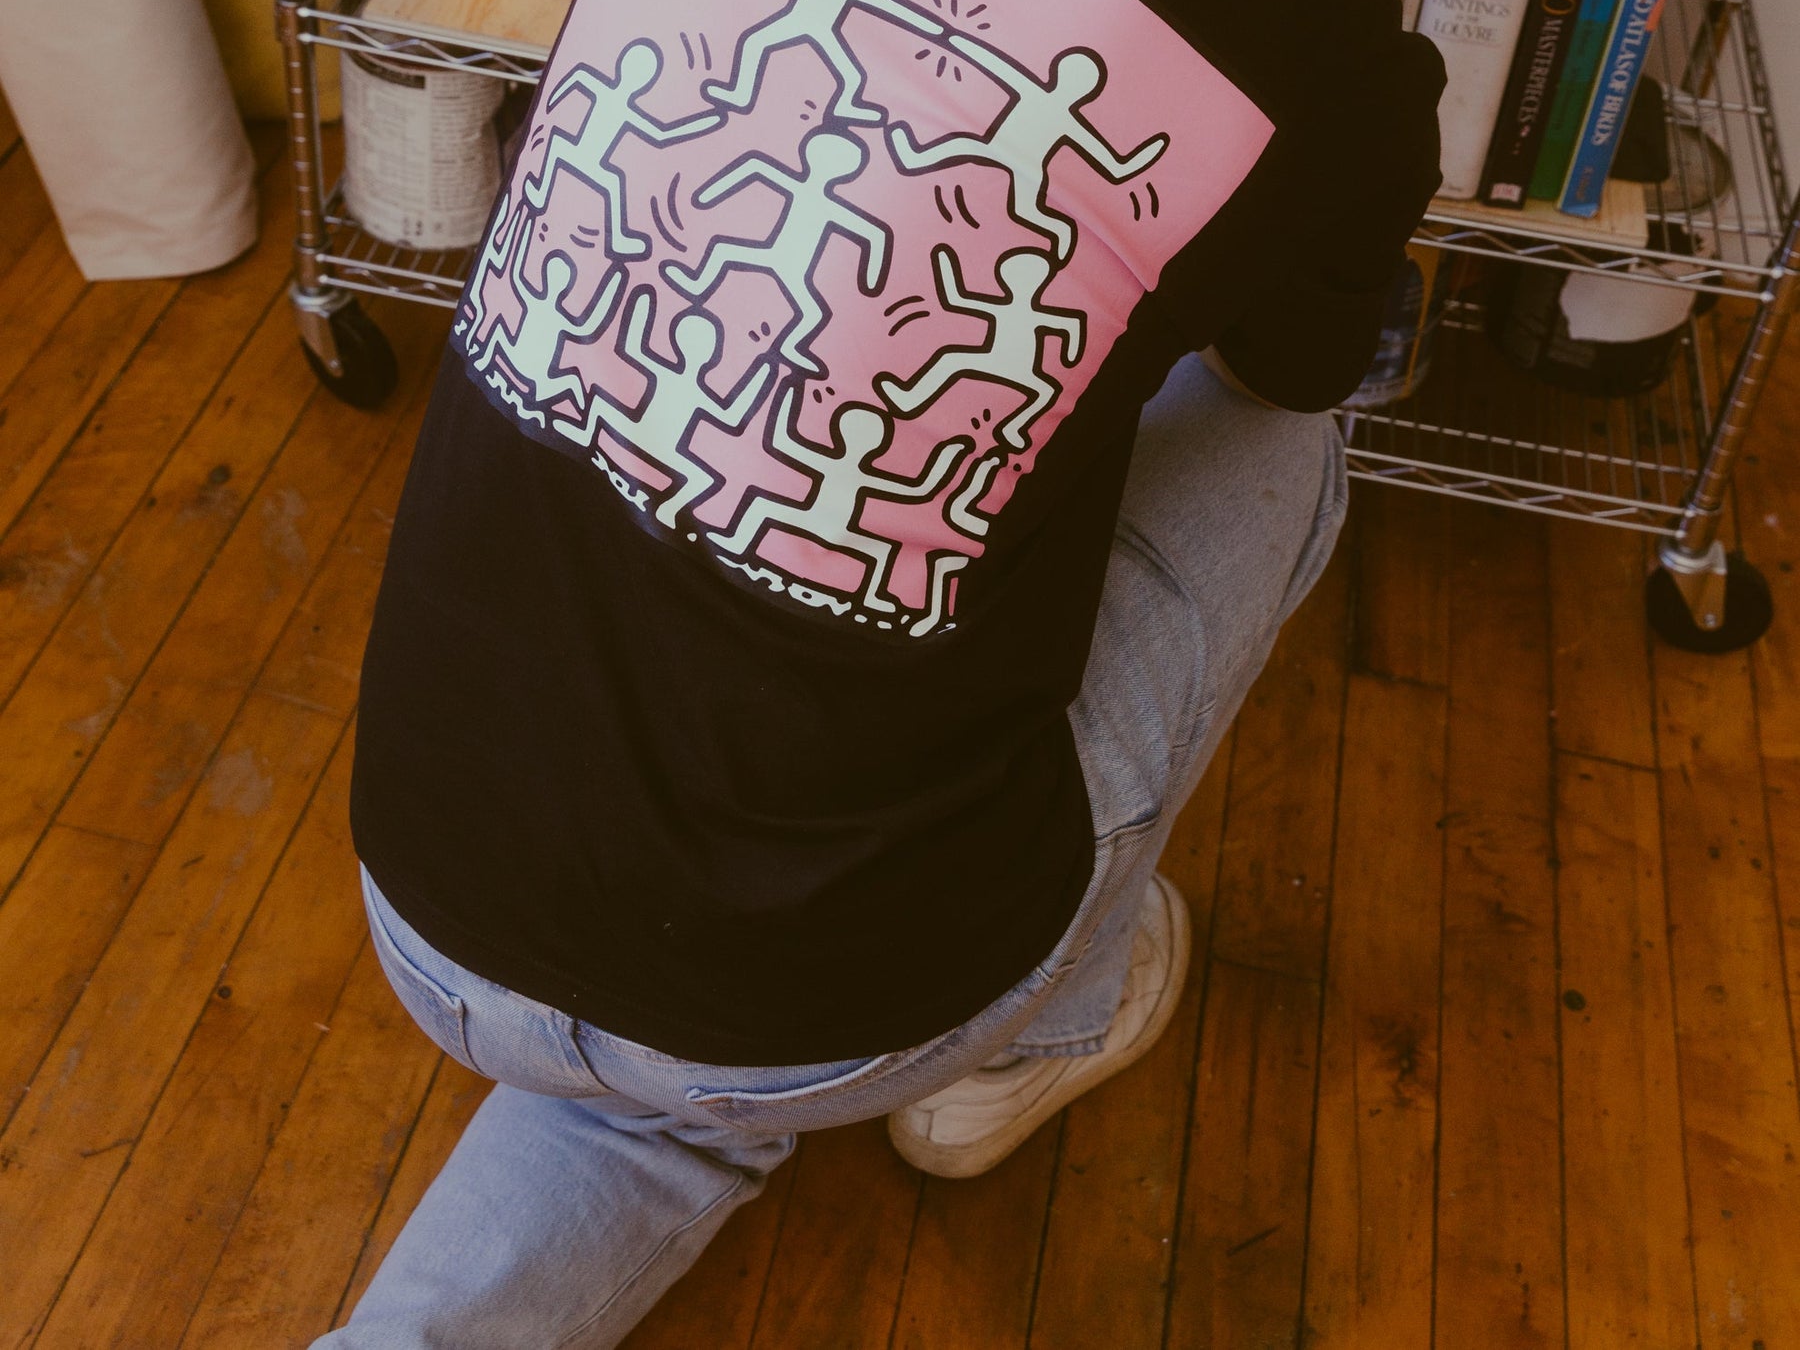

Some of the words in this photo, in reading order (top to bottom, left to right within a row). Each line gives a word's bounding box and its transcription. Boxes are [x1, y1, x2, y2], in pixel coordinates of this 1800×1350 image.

[1518, 17, 1565, 124] MASTERPIECES
[1612, 13, 1646, 72] ATLAS
[1608, 68, 1632, 95] OF
[1591, 93, 1625, 146] BIRDS
